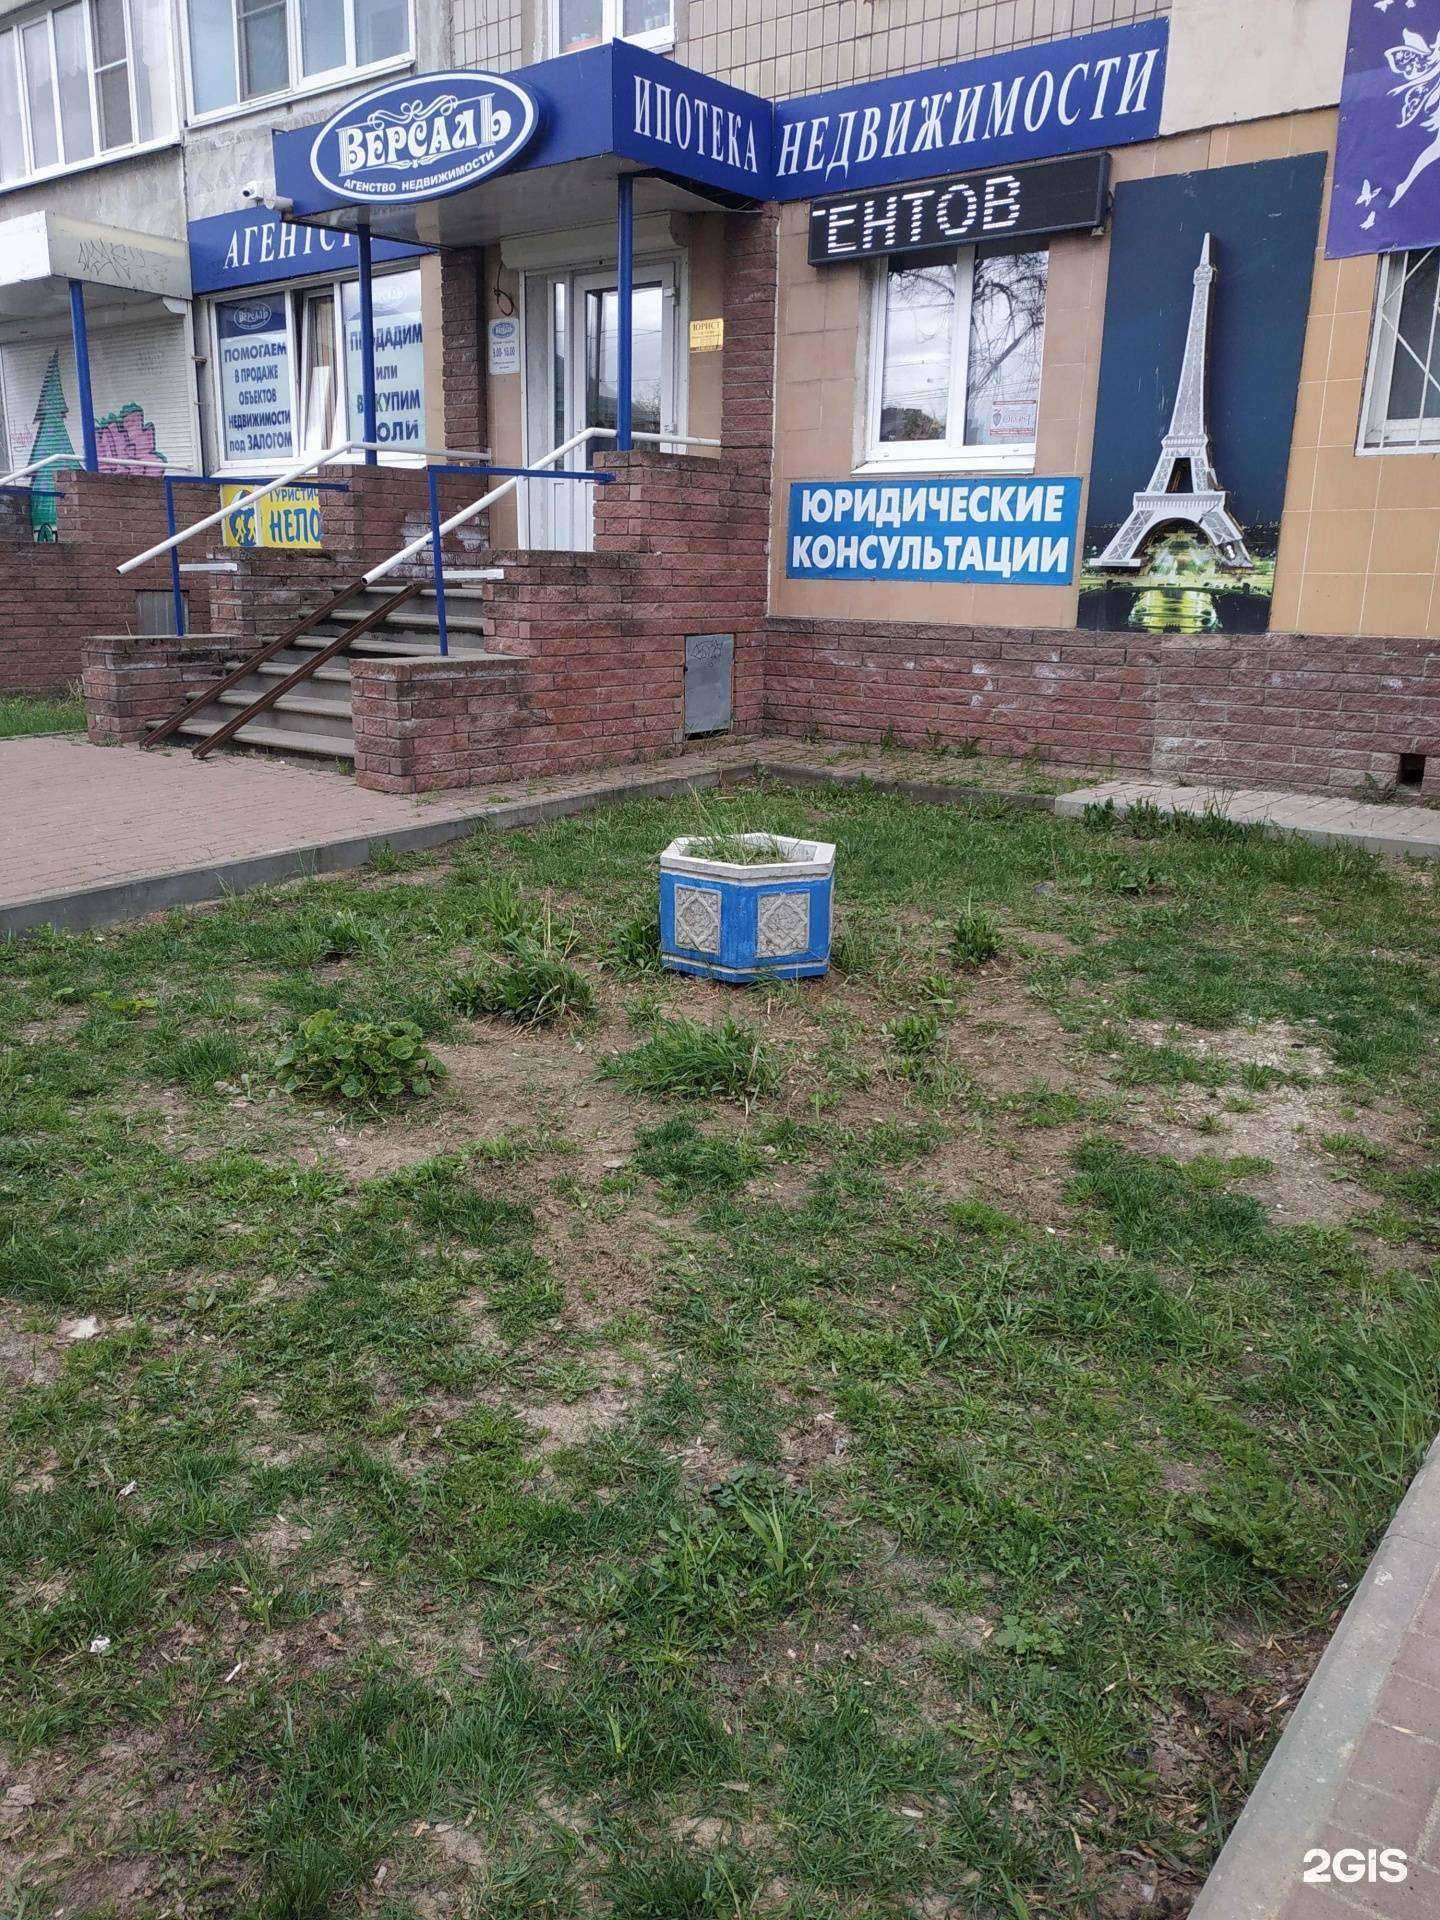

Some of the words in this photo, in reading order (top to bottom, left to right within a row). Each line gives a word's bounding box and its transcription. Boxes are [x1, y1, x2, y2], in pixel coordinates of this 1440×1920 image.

[633, 75, 758, 174] ИПОТЕКА
[776, 49, 1160, 183] НЕДВИЖИМОСТИ
[335, 93, 512, 177] ВЕРСАЛЬ
[343, 178, 397, 193] АГЕНСТВО
[401, 149, 496, 192] НЕДВИЖИМОСТИ
[812, 175, 1021, 254] ЕНТОВ
[350, 323, 423, 352] ПДАДИМ
[224, 342, 287, 363] ПОМОГАЕМ
[234, 369, 240, 384] В
[241, 364, 279, 384] ПРОДАЖЕ
[376, 364, 398, 381] ИЛИ
[238, 387, 278, 406] ОБЪЕКТОВ
[356, 388, 421, 415] ВКУПИМ
[228, 409, 291, 432] НЕДВИЖИМОСТИ
[363, 419, 420, 444] ОЛИ
[229, 439, 247, 453] под
[247, 430, 293, 450] ЗАЛОГОМ
[801, 486, 1065, 528] ЮРИДИЧЕСКИЕ
[269, 507, 321, 544] НЕПО
[792, 534, 1070, 578] КОНСУЛЬТАЦИИ
